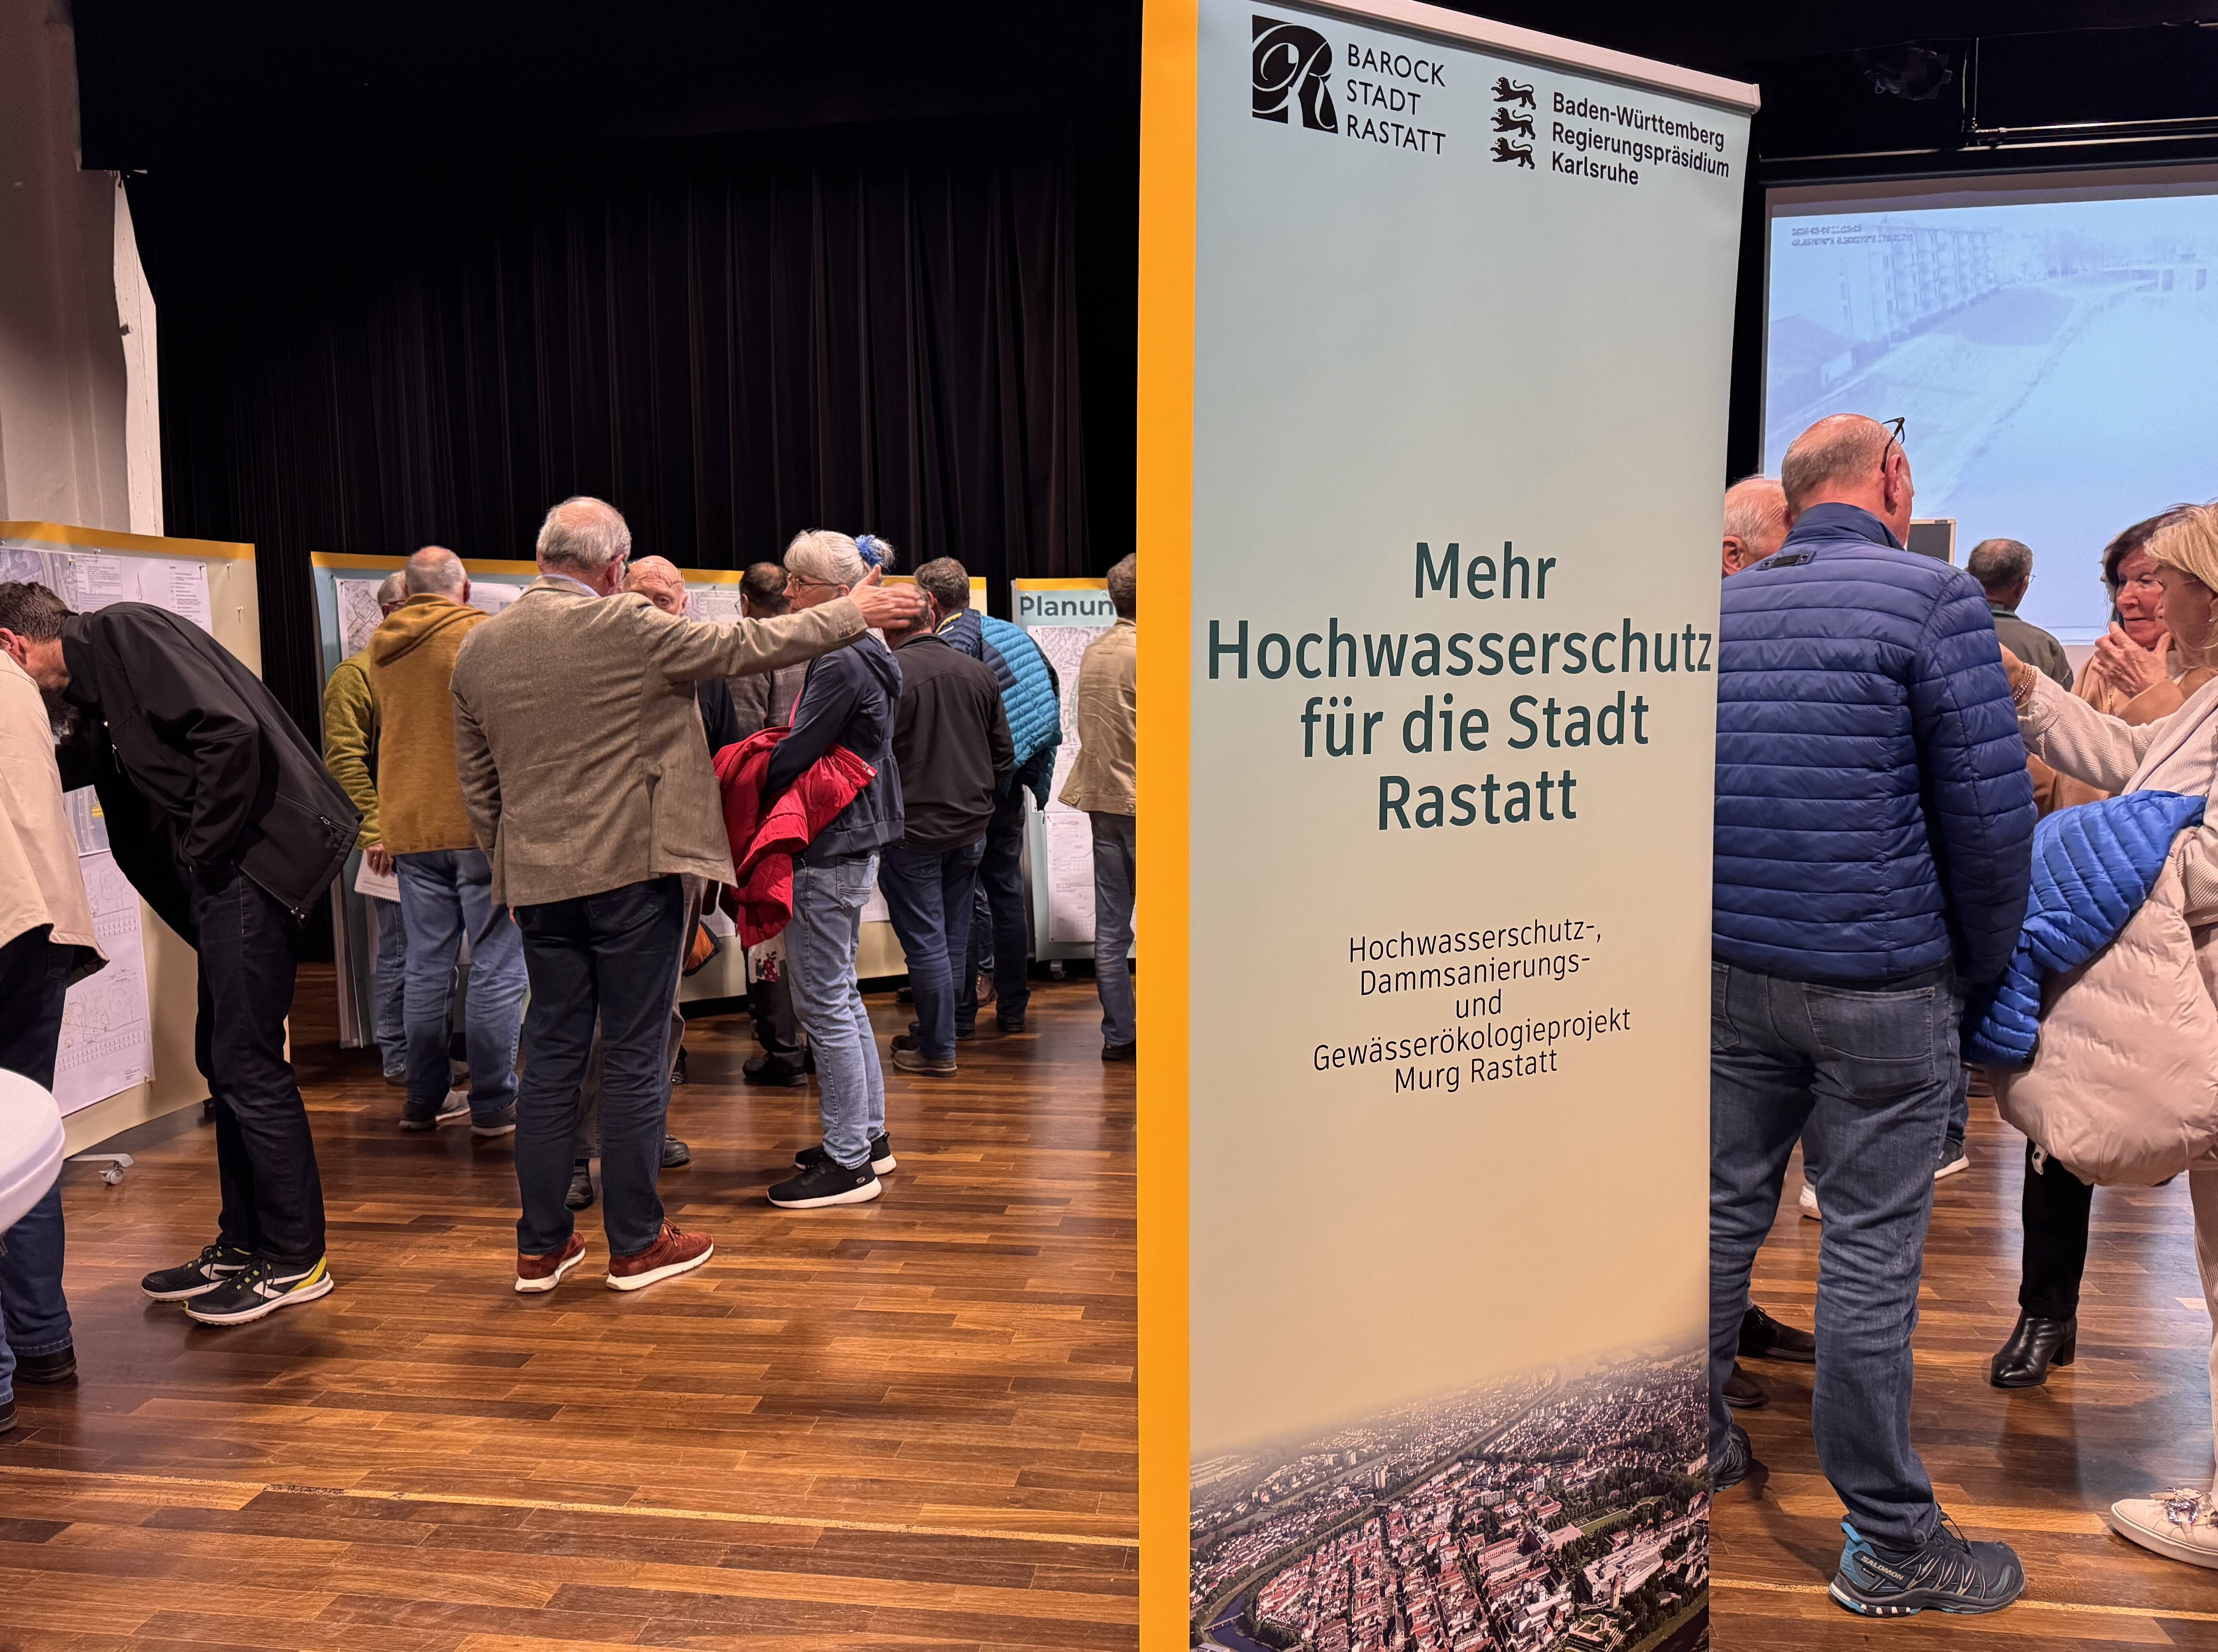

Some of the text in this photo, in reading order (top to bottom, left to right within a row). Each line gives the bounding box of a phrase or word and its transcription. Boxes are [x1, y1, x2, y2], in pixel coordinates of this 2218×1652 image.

[1348, 43, 1446, 87] BAROCK
[1347, 79, 1421, 116] STADT
[1347, 114, 1446, 155] RASTATT
[1553, 91, 1724, 153] Baden-Württemberg
[1552, 121, 1729, 178] Regierungspräsidium
[1552, 150, 1639, 185] Karlsruhe
[1415, 540, 1557, 600] Mehr
[1209, 617, 1712, 680] Hochwasserschutz
[1300, 690, 1649, 758] für die Stadt
[1378, 769, 1577, 831] Rastatt
[1350, 918, 1601, 963] Hochwasserschutz-,
[1361, 954, 1590, 996] Dammsanierungs-
[1456, 988, 1502, 1019] und
[1314, 1007, 1631, 1071] Gewässerökologieprojekt
[1395, 1049, 1558, 1094] Murg Rastatt
[1861, 1556, 1904, 1580] SALOMON
